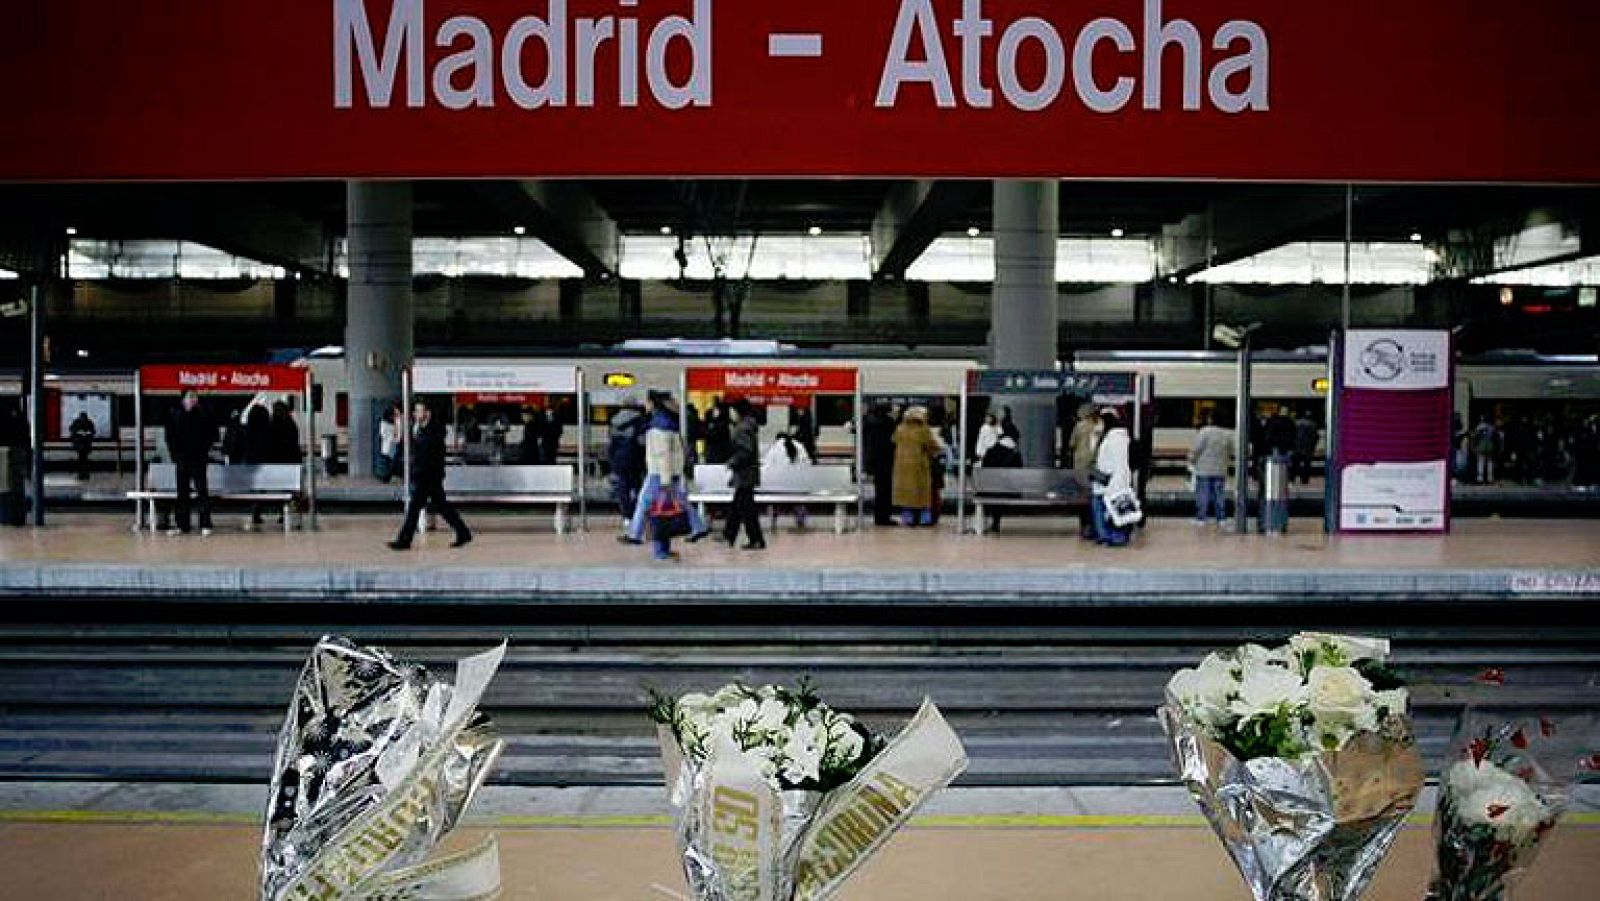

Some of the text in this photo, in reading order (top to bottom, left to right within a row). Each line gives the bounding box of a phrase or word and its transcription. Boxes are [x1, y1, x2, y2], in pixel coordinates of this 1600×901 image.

[333, 0, 1270, 113] Madrid - Atocha
[178, 370, 217, 385] Madrid
[231, 370, 269, 386] Atocha
[725, 371, 766, 386] Madrid
[778, 372, 819, 387] Atocha
